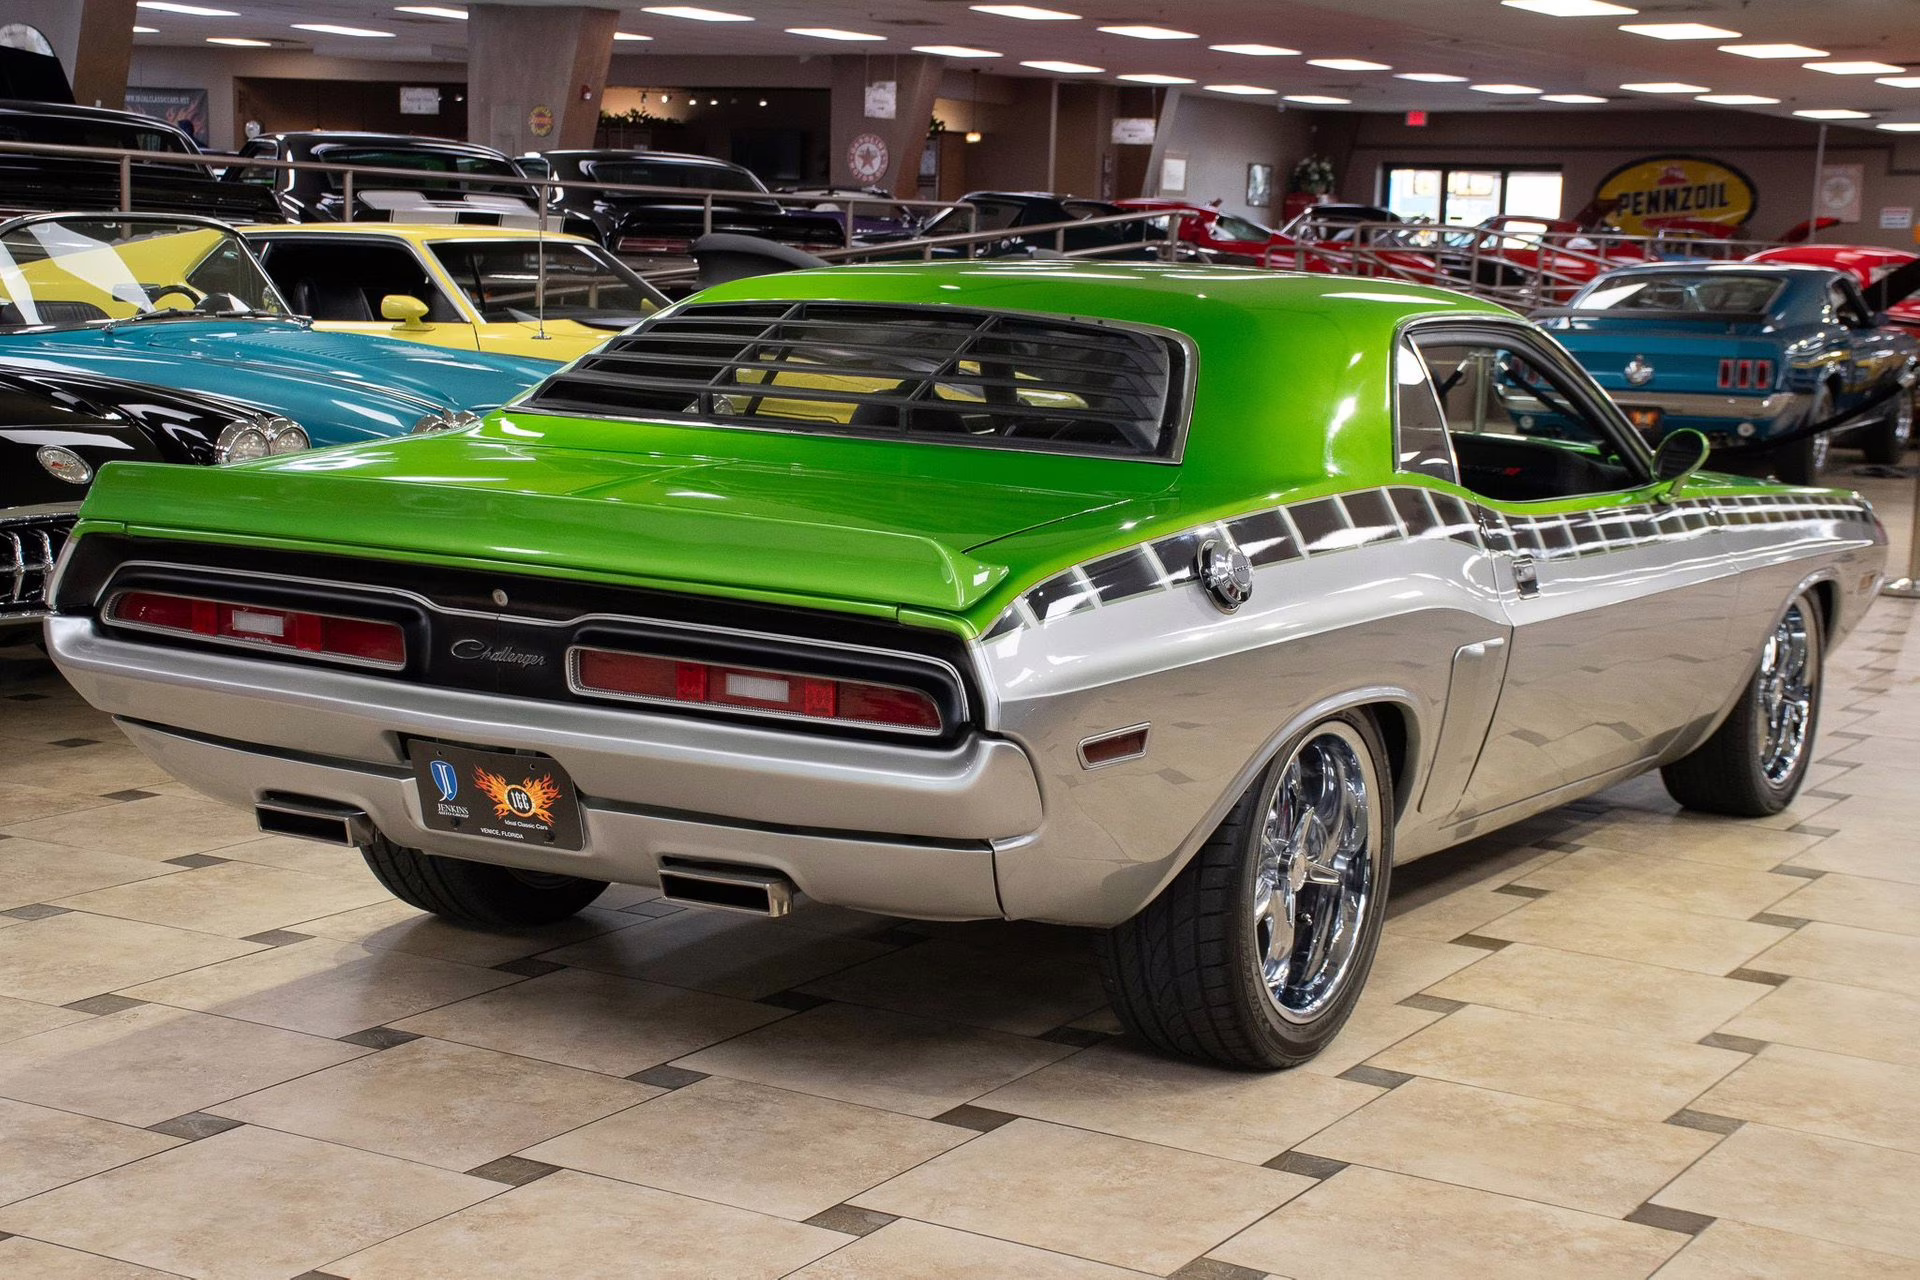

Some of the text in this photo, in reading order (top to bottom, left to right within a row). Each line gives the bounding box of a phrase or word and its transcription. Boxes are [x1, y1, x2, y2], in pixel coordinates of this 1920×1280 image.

[1617, 183, 1729, 217] PENNZOIL
[451, 639, 546, 667] Challenger
[438, 803, 469, 815] JENKINS
[511, 792, 530, 811] ICC
[502, 831, 525, 839] FLORIDA
